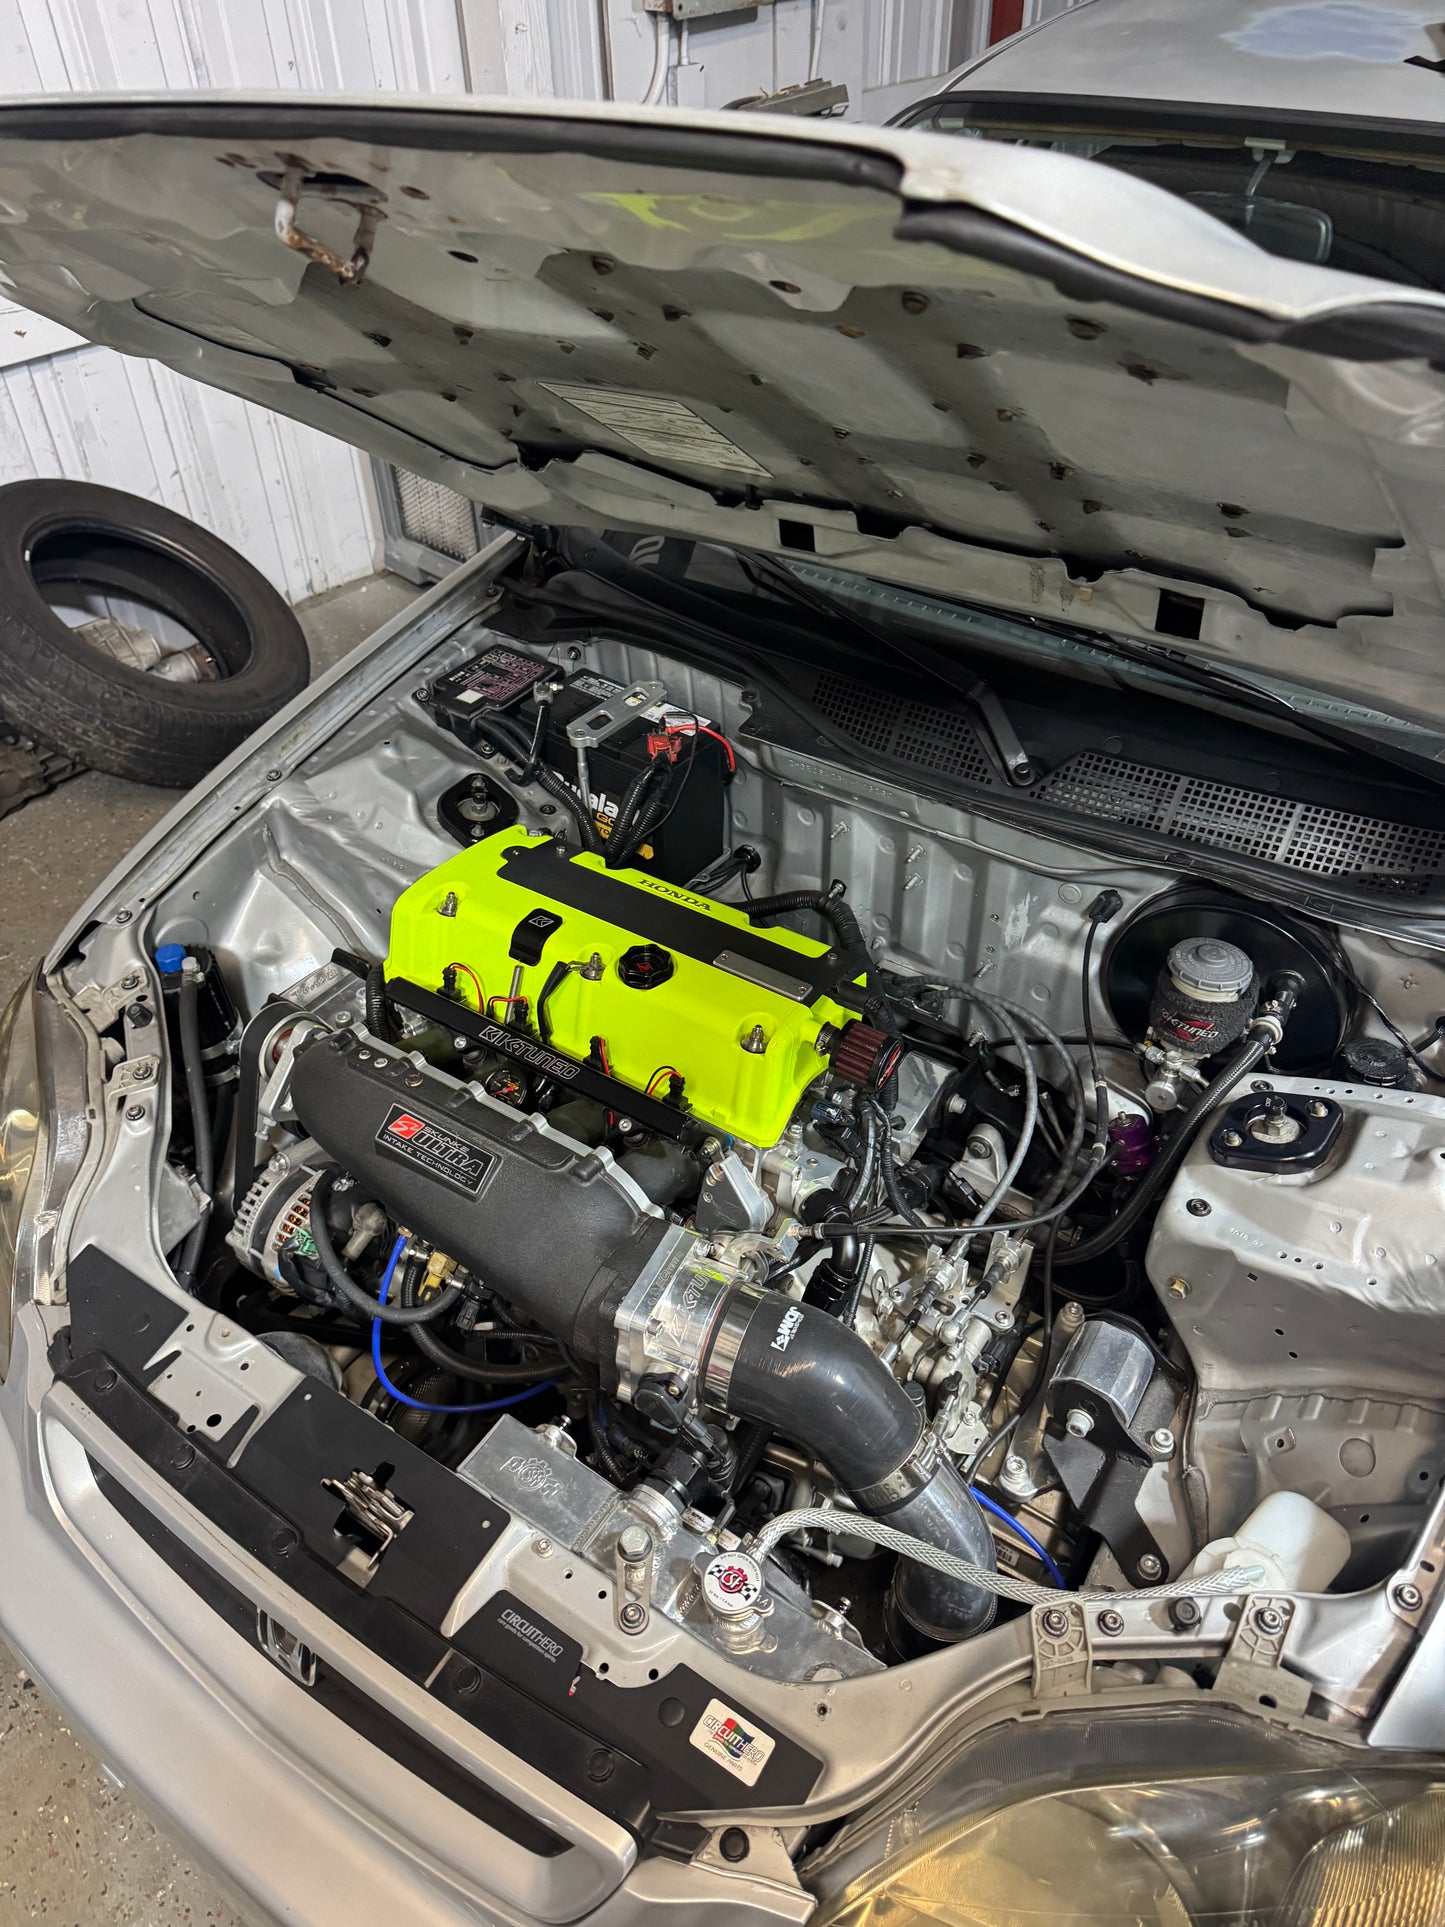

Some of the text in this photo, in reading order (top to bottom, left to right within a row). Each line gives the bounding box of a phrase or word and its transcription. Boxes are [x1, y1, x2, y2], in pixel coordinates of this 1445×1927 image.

[638, 879, 712, 912] HONDA
[494, 1032, 581, 1080] K-TUNED
[382, 1134, 474, 1186] INTAKE TECHNOLOGY
[411, 1130, 484, 1177] ULTRA
[777, 1306, 804, 1336] JDM
[736, 1554, 749, 1562] OPEN
[720, 1570, 743, 1589] CSF
[501, 1609, 563, 1657] CIRCUITHERO
[703, 1715, 765, 1762] CIRCUITHERO
[703, 1742, 727, 1760] GENUINE
[726, 1758, 743, 1772] PARTS
